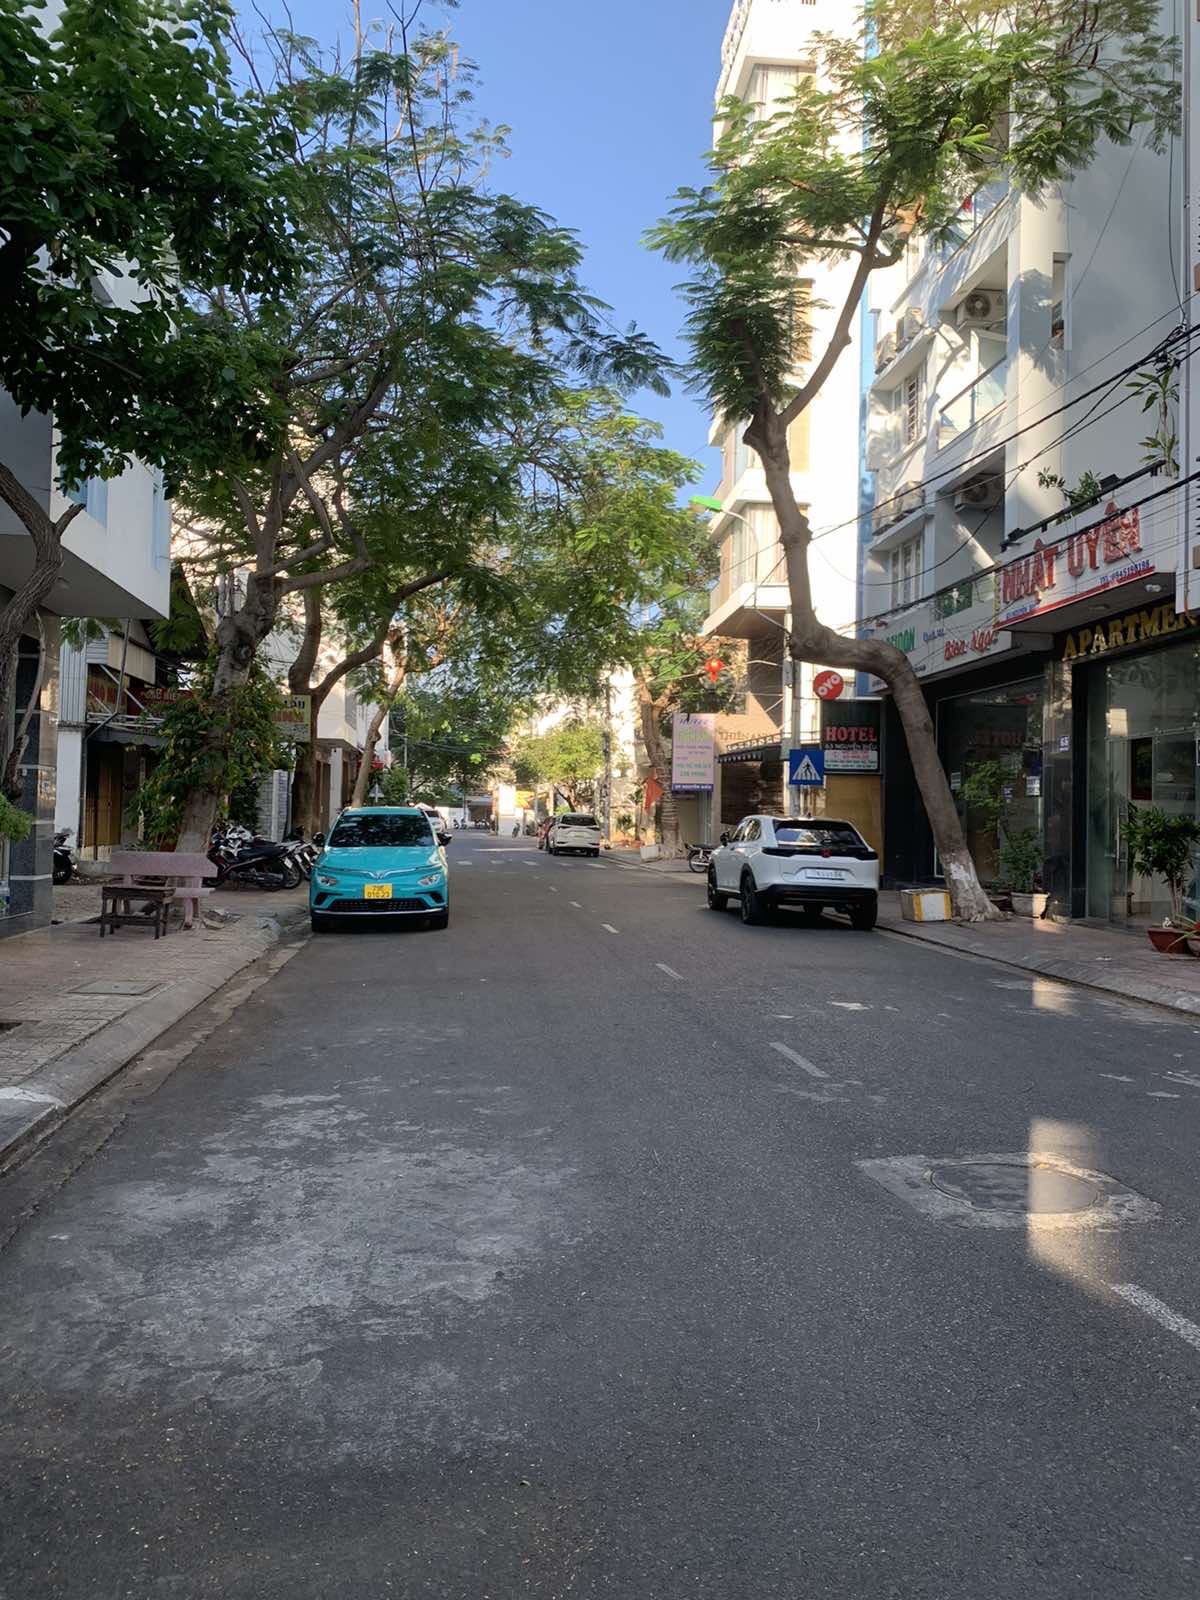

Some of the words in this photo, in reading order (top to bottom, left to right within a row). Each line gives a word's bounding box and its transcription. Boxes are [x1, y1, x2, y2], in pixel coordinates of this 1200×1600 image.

[1002, 538, 1059, 604] NHẬT
[1067, 501, 1143, 577] UYÊN
[818, 674, 841, 697] OYO
[826, 726, 877, 742] HOTEL
